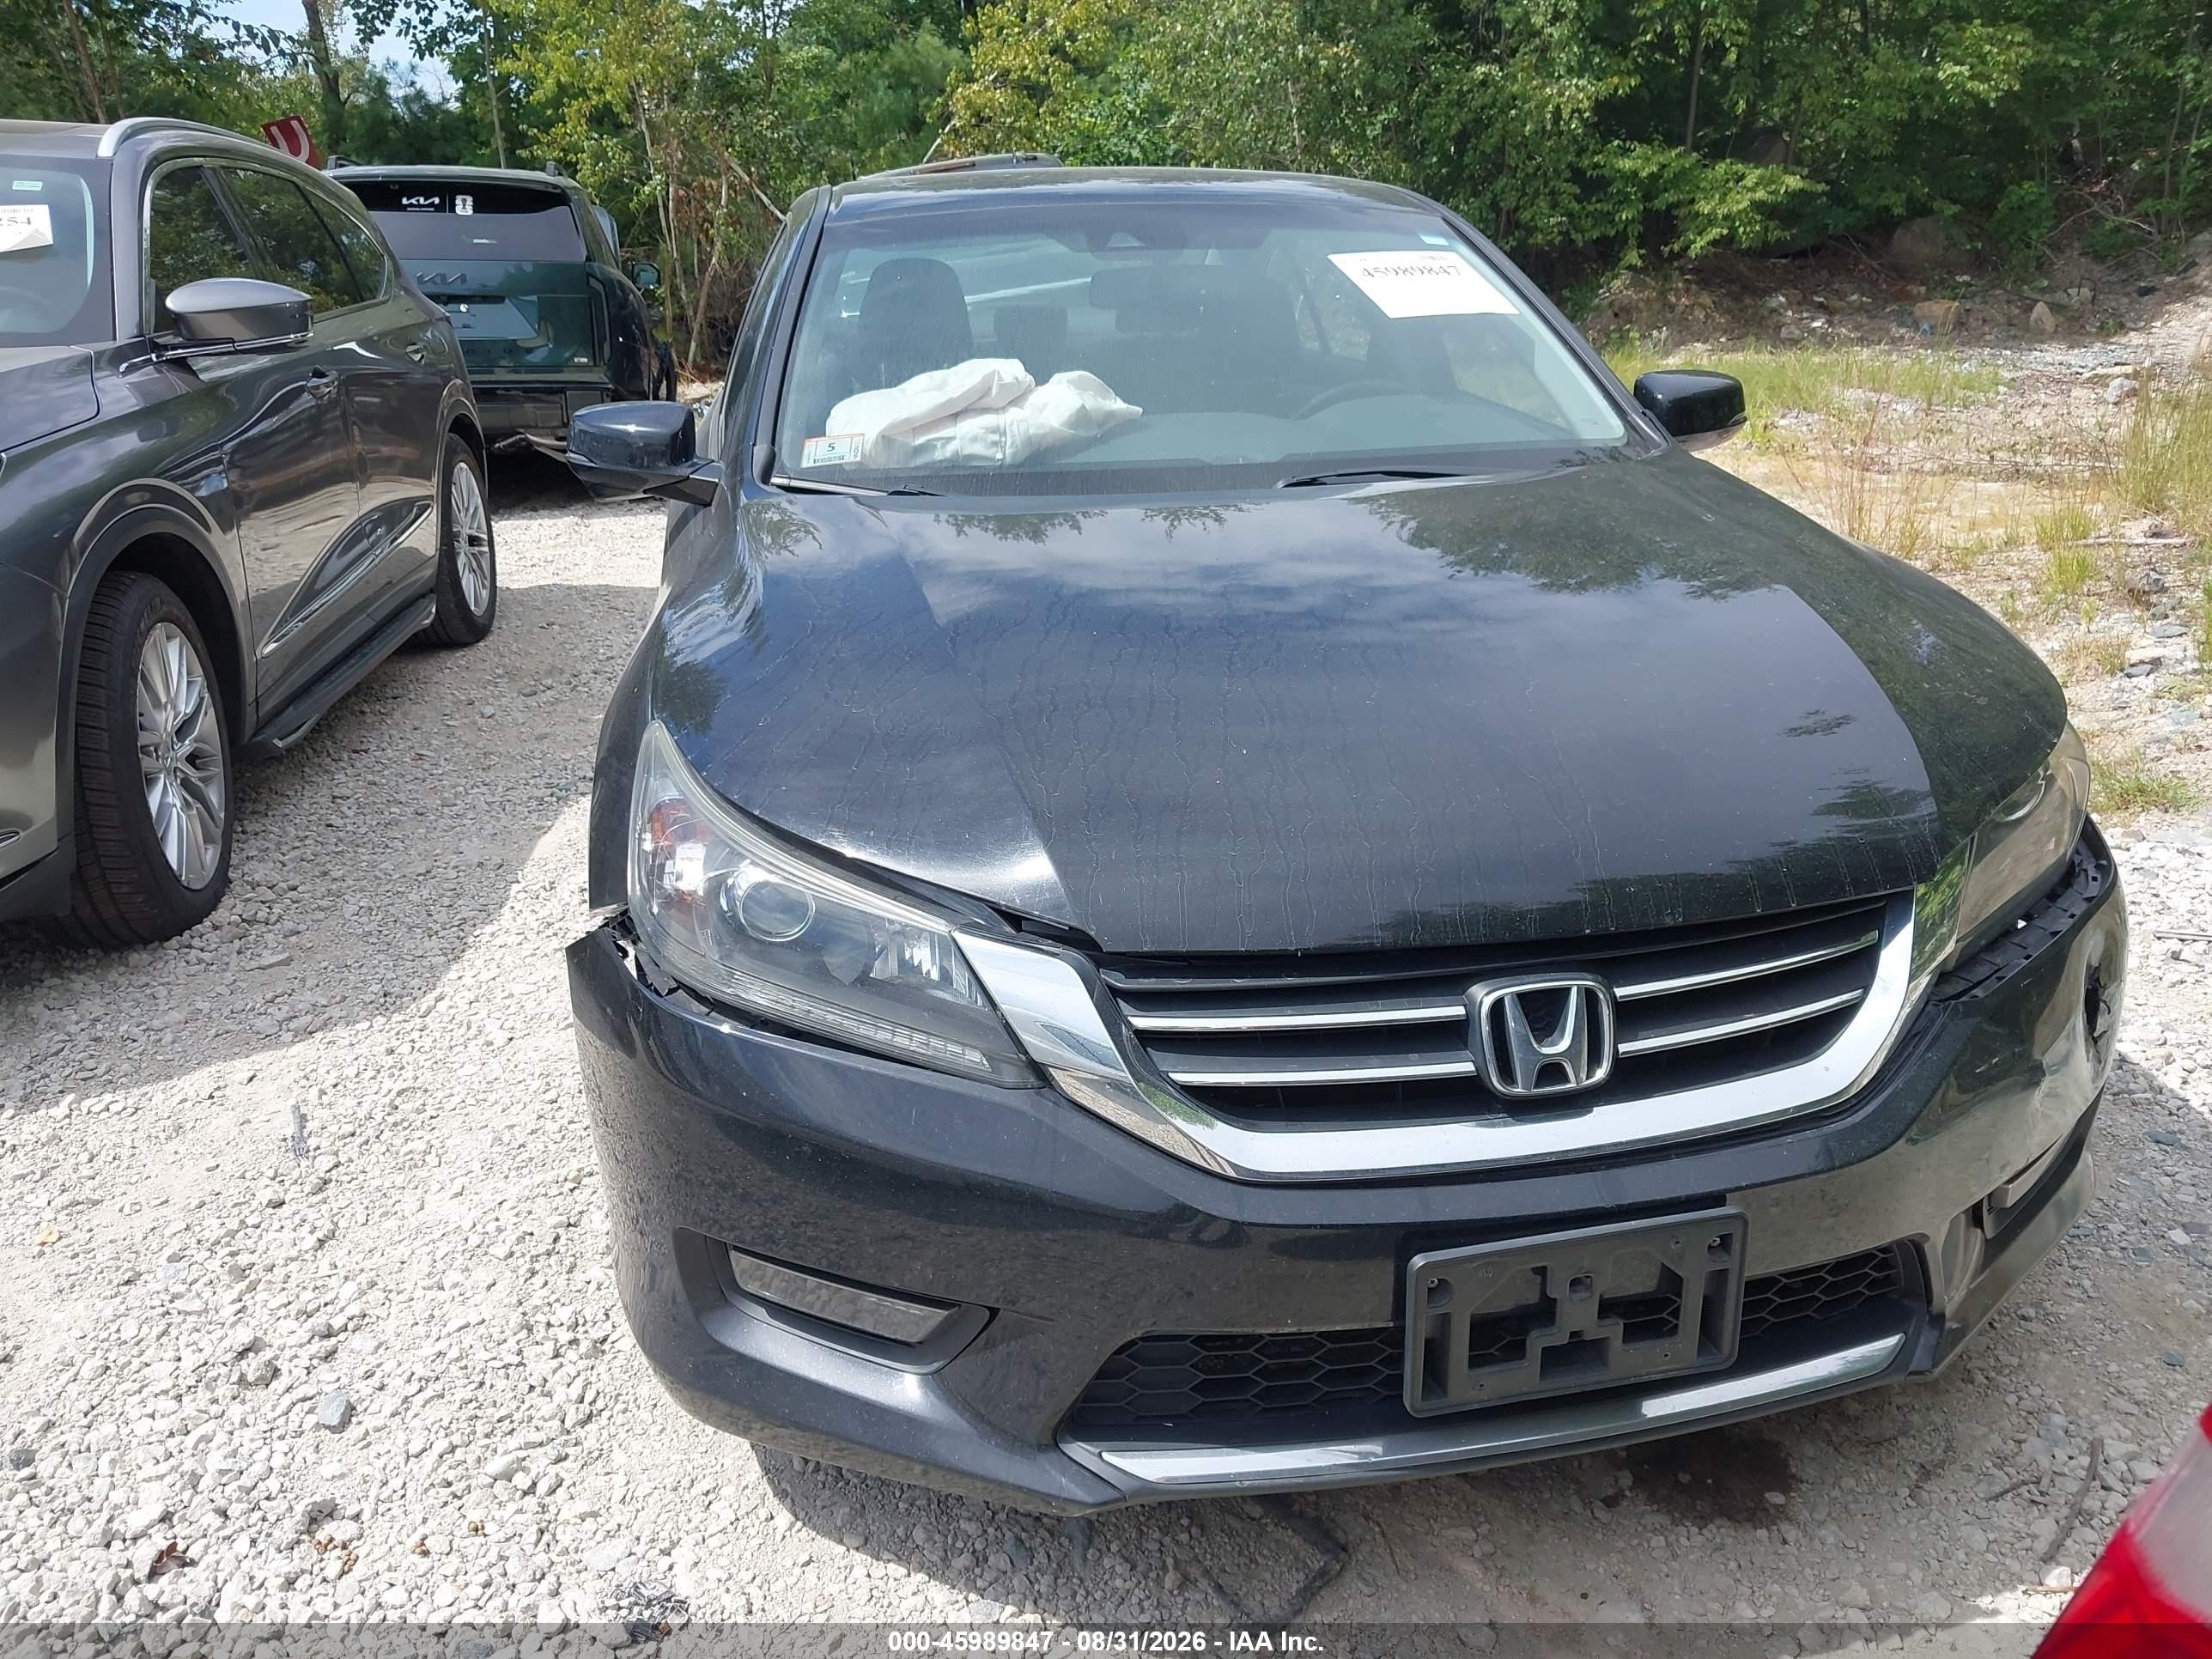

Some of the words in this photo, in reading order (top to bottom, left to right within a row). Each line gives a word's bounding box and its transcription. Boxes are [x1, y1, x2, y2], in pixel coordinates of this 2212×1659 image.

[402, 196, 440, 205] KIA
[1362, 264, 1462, 278] 45989847
[416, 271, 467, 286] KIA
[827, 442, 836, 453] 5
